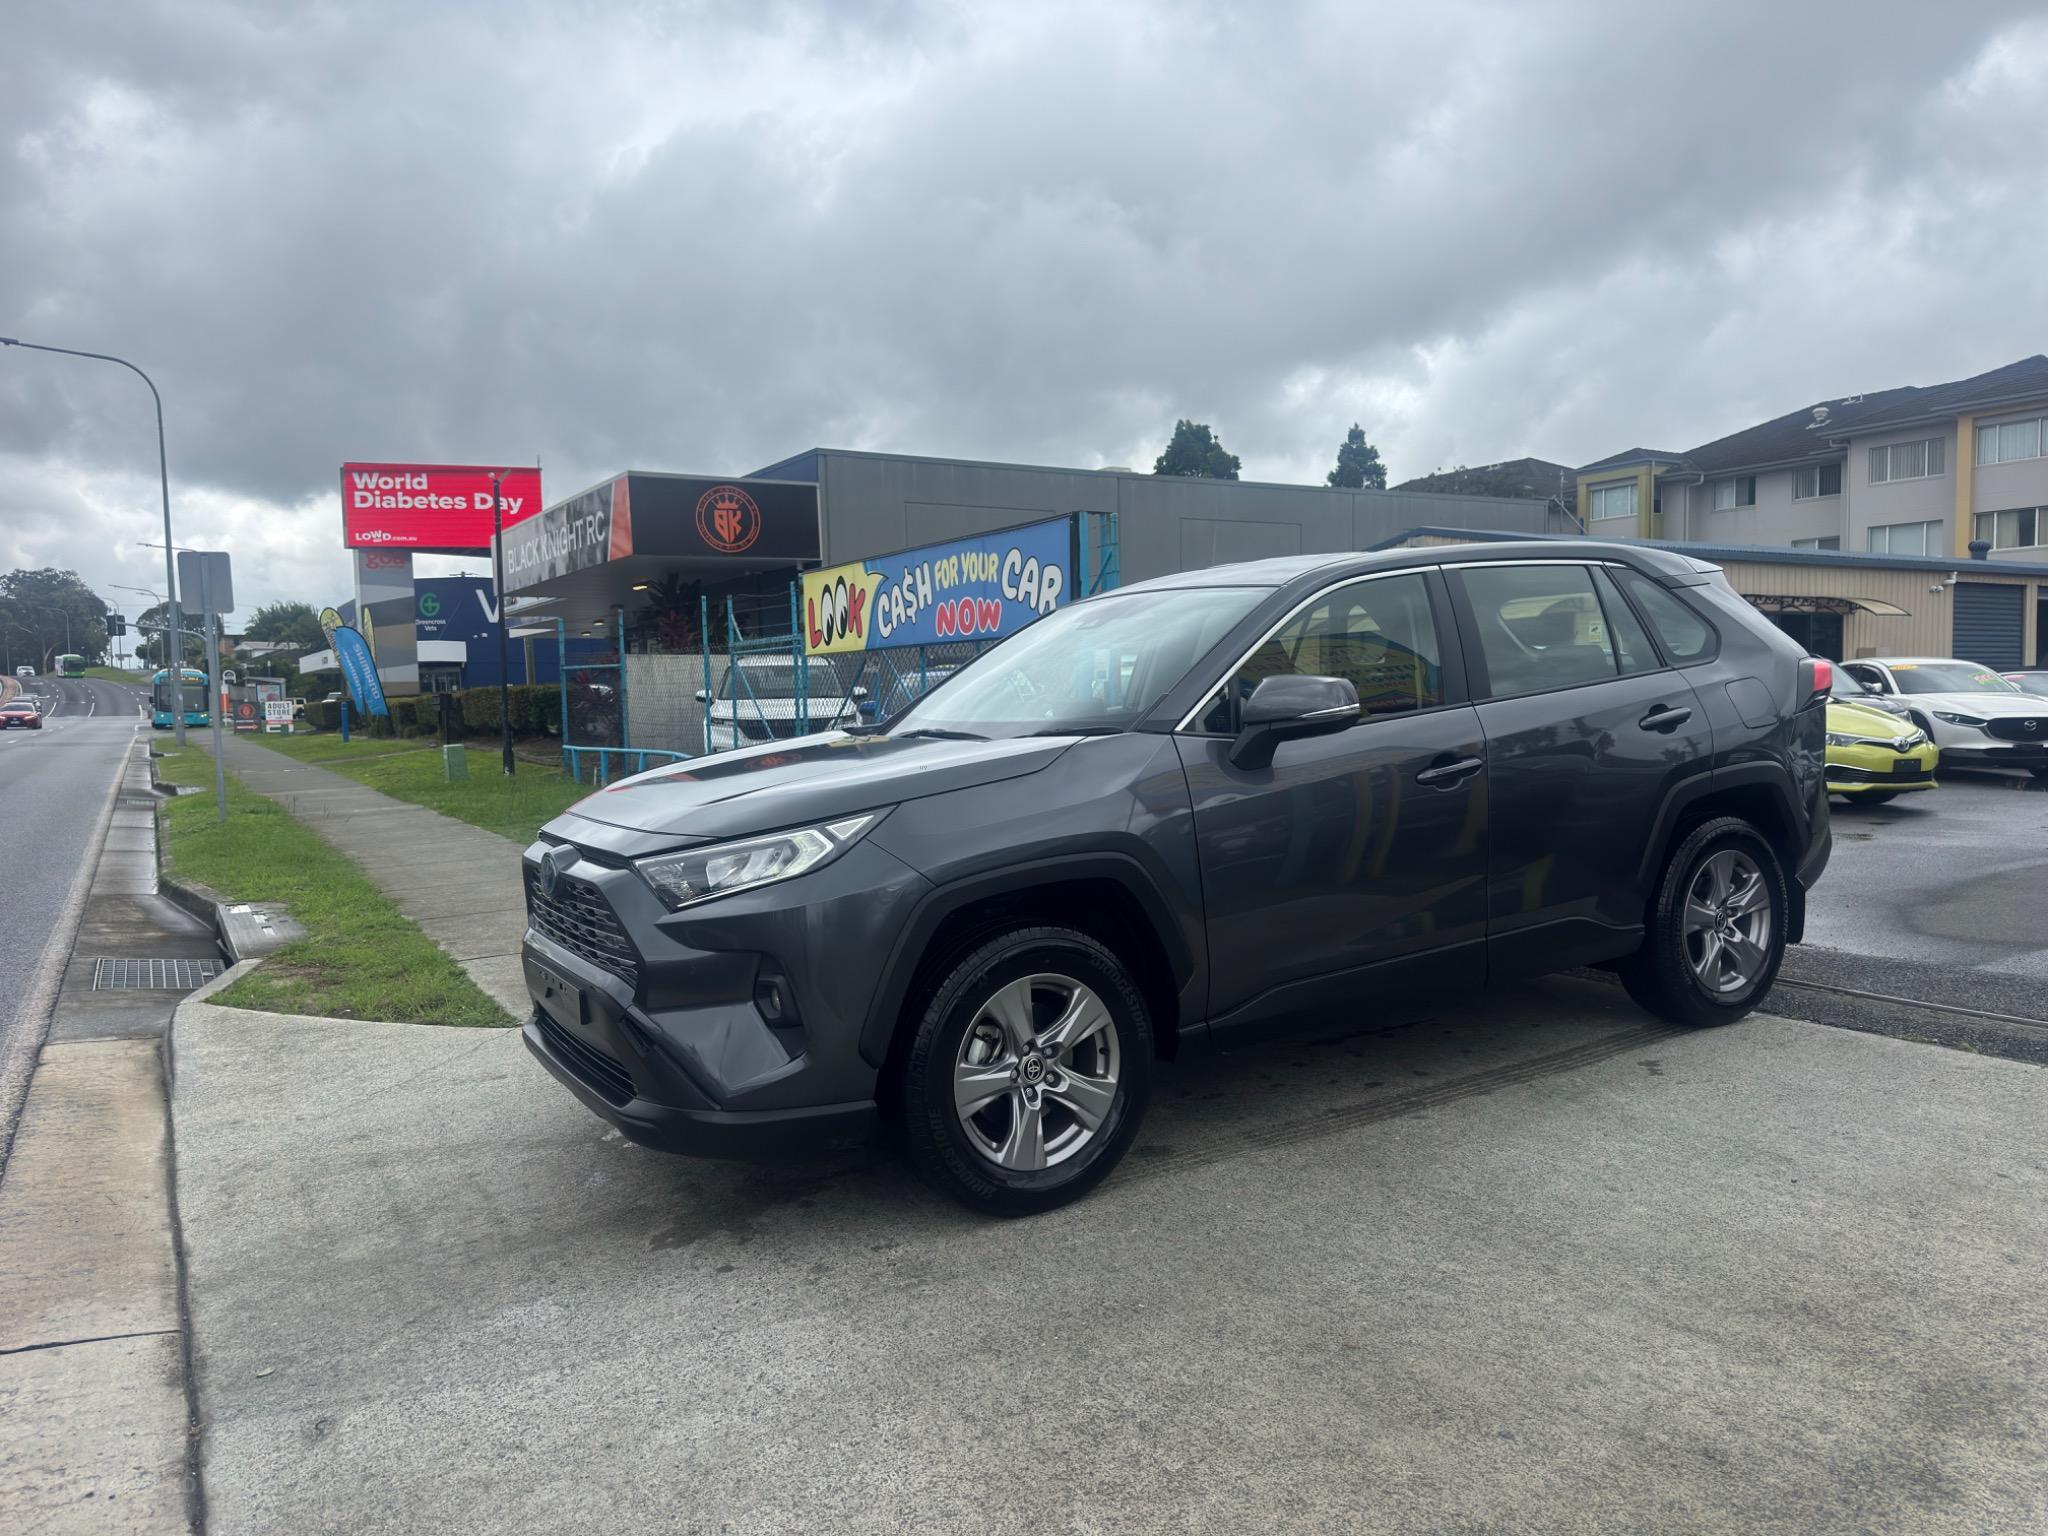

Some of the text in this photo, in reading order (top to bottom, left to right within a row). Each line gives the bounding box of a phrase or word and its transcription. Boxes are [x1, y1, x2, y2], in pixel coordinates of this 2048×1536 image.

[352, 472, 428, 490] World
[354, 491, 523, 515] Diabetes Day
[508, 511, 606, 575] BLACK KNIGHT RC
[808, 576, 866, 649] LOOK
[877, 547, 1063, 639] CA$H FOR YOUR CAR
[935, 596, 1002, 637] NOW
